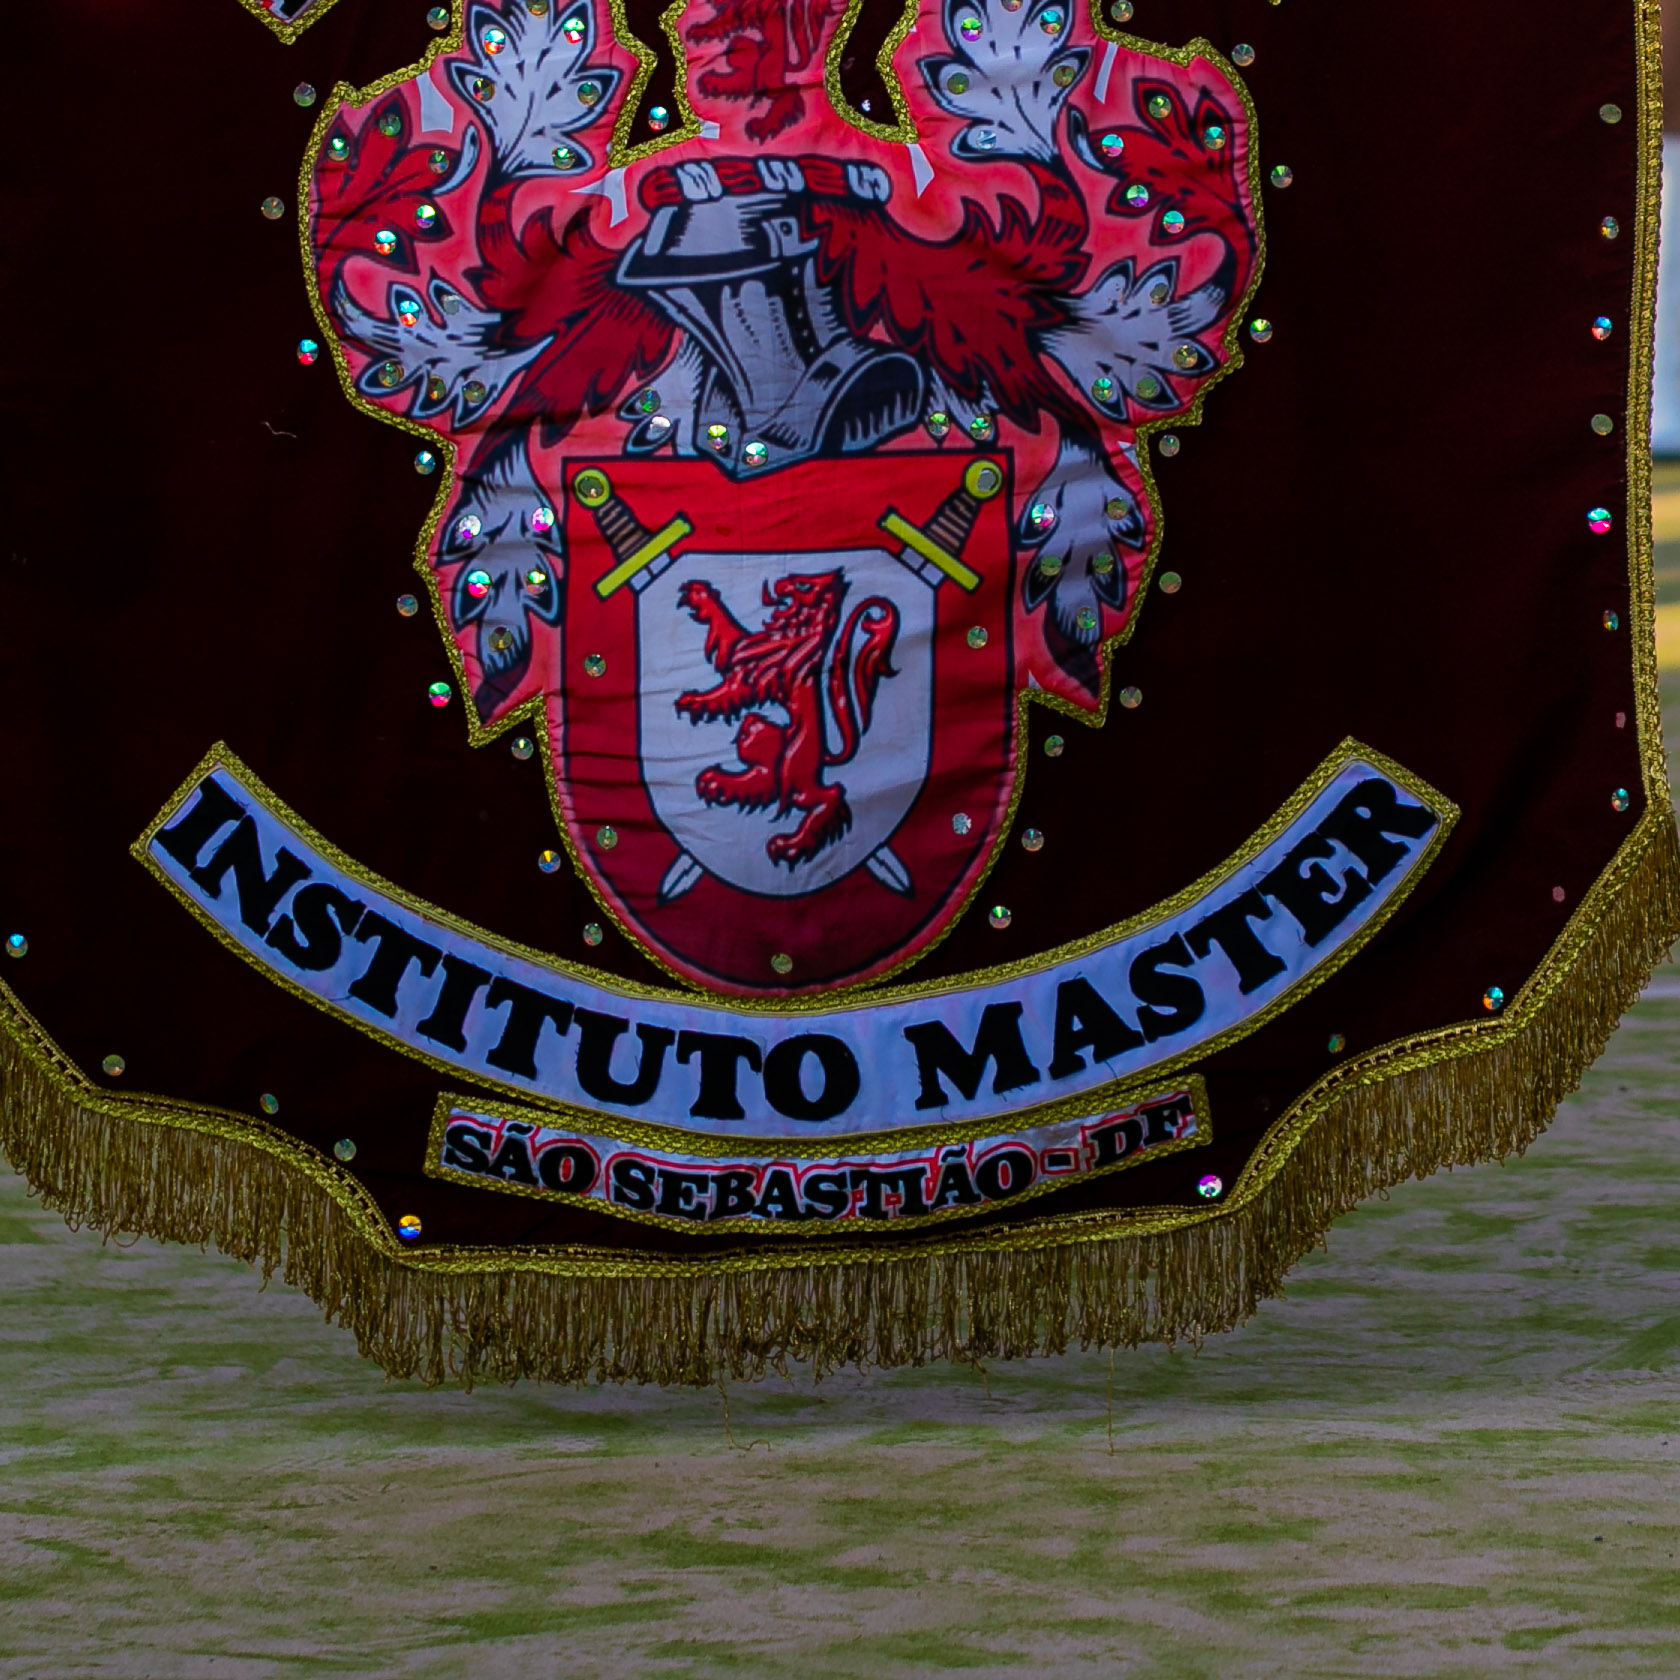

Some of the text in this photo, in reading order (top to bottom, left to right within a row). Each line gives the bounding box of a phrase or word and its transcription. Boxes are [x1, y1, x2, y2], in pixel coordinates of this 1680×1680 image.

[158, 777, 1437, 1121] INSTITUTO MASTER
[444, 1124, 593, 1192] SÃO
[613, 1146, 1033, 1220] SEBASTIÃO
[1092, 1096, 1193, 1162] DF
